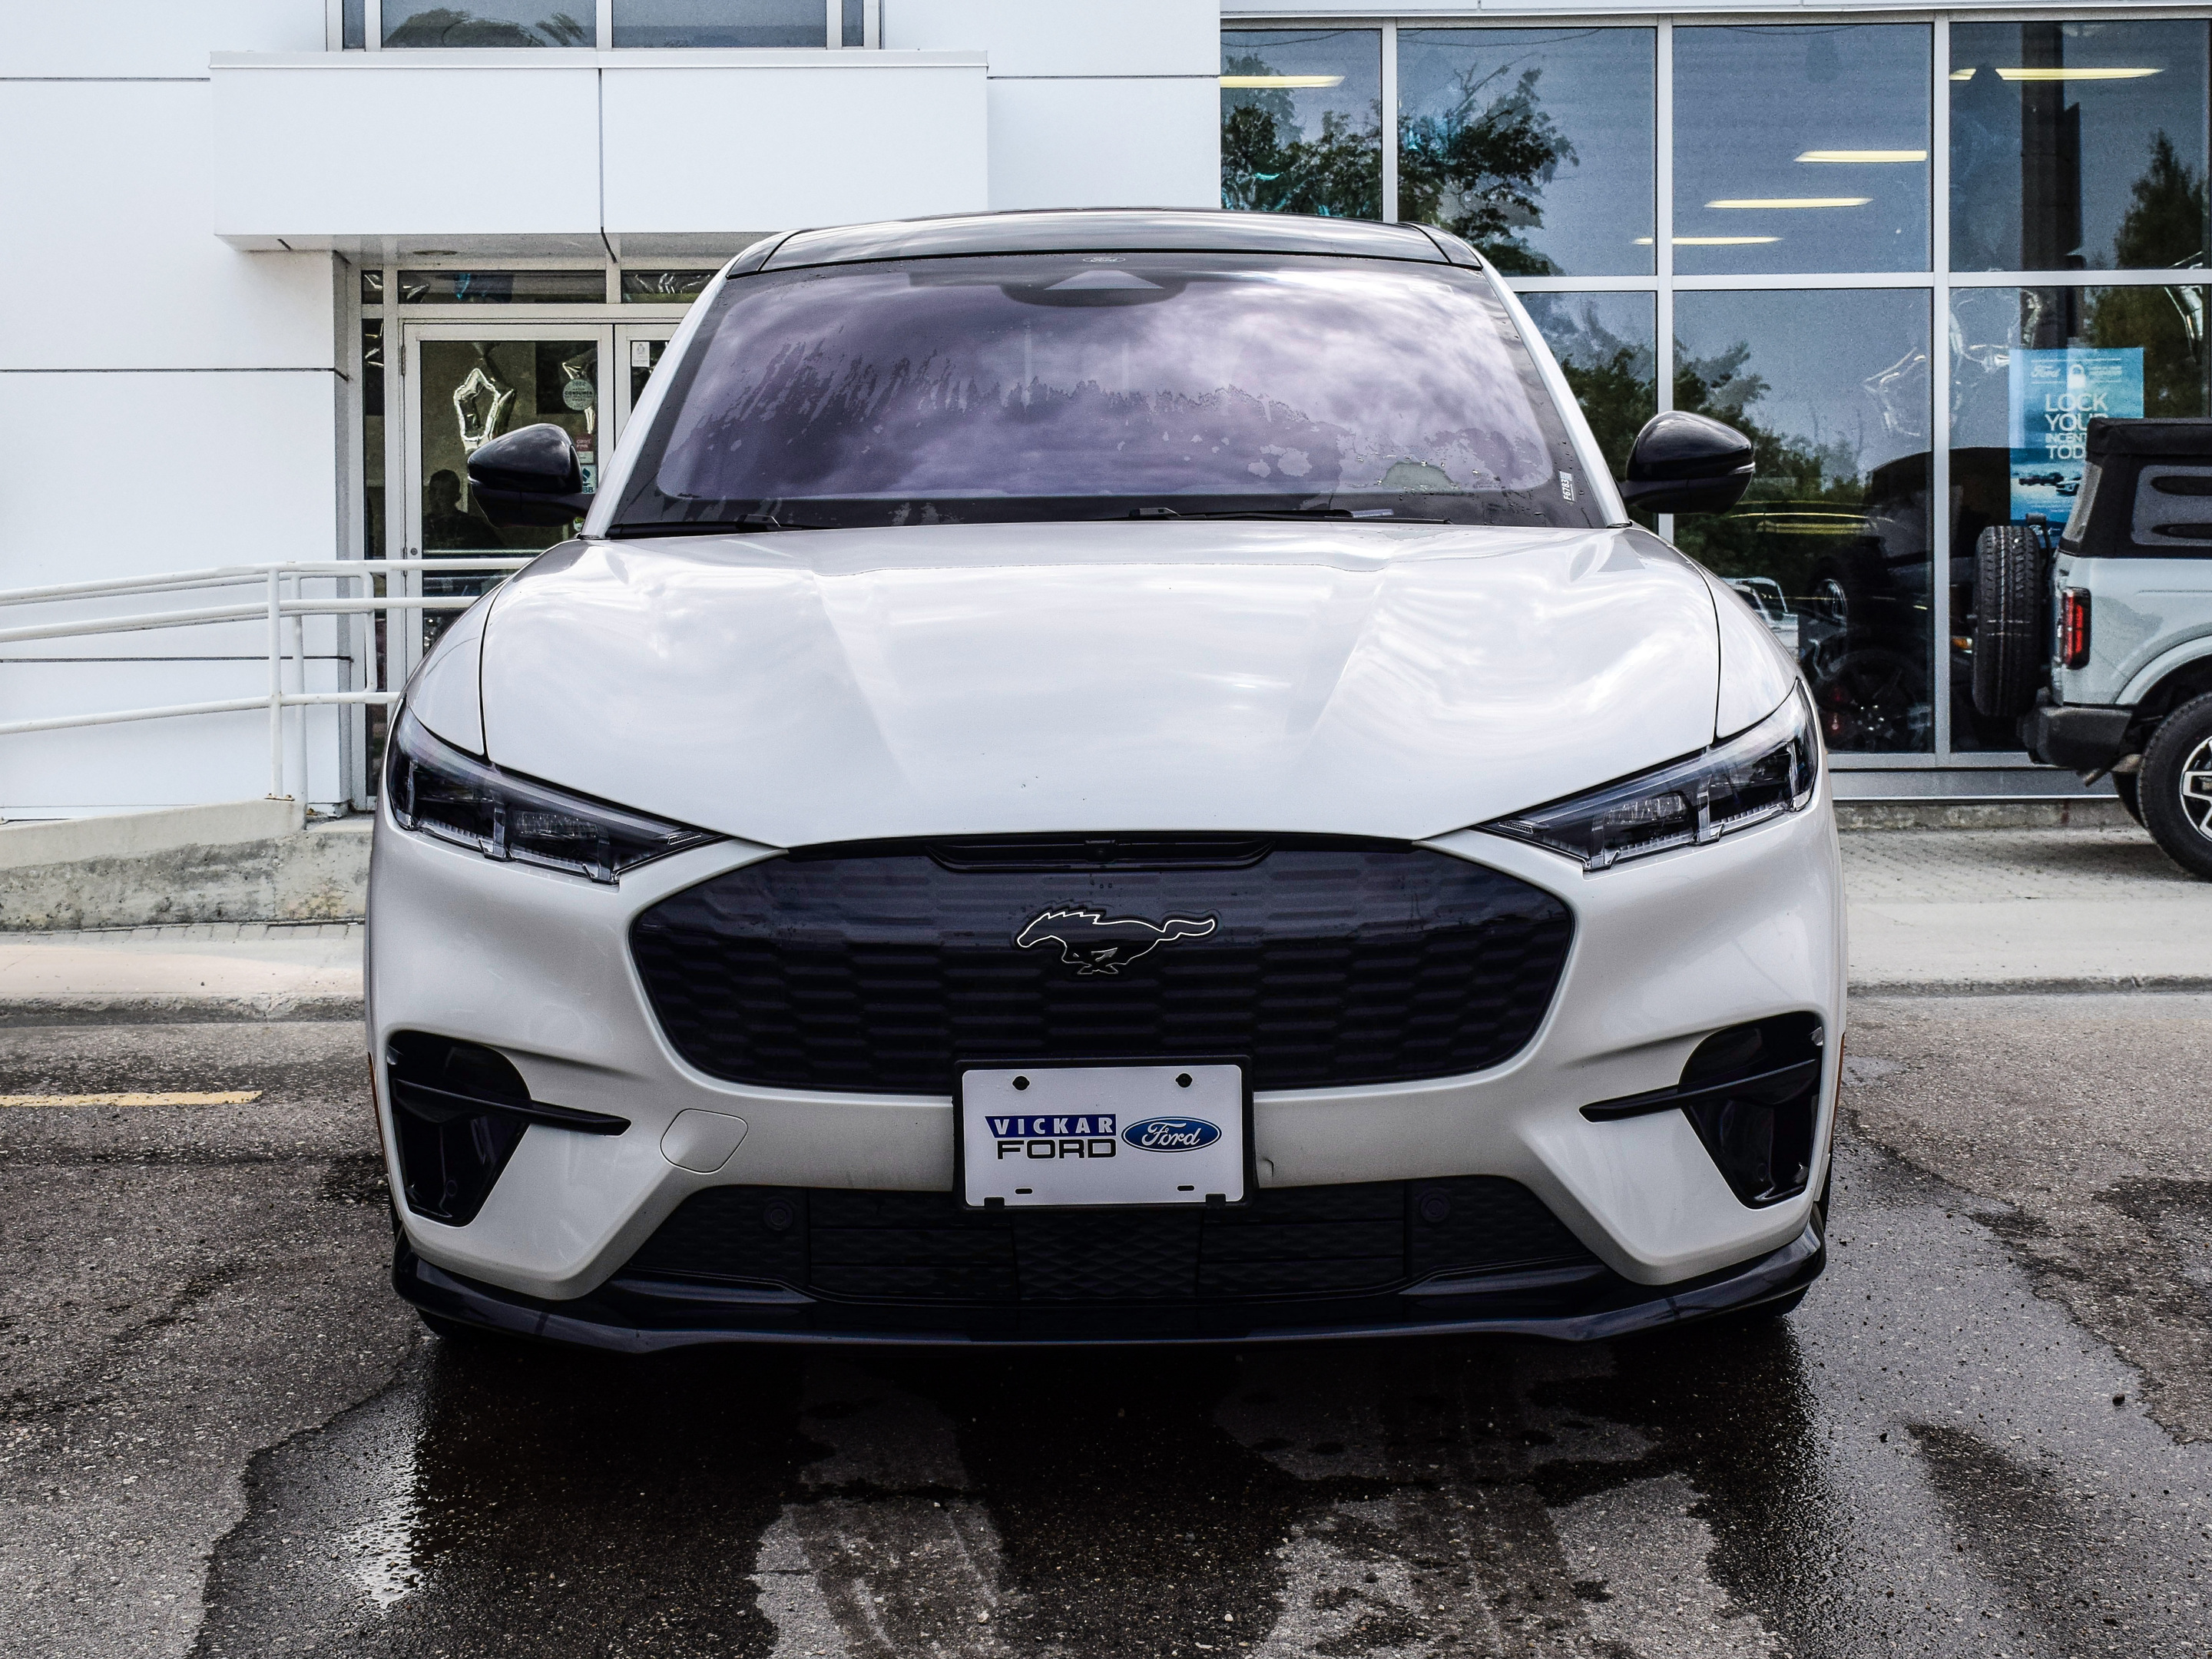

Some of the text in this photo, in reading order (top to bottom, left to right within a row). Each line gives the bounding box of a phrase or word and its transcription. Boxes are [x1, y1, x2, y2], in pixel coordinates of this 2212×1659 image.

[2045, 392, 2108, 412] LOCK
[2045, 412, 2108, 431] YOU
[2045, 432, 2088, 443] INCENT
[2045, 445, 2087, 459] TOD
[1561, 478, 1572, 501] F6783
[994, 1117, 1114, 1135] VICKAR
[1141, 1121, 1203, 1147] Ford
[997, 1138, 1117, 1160] FORD
